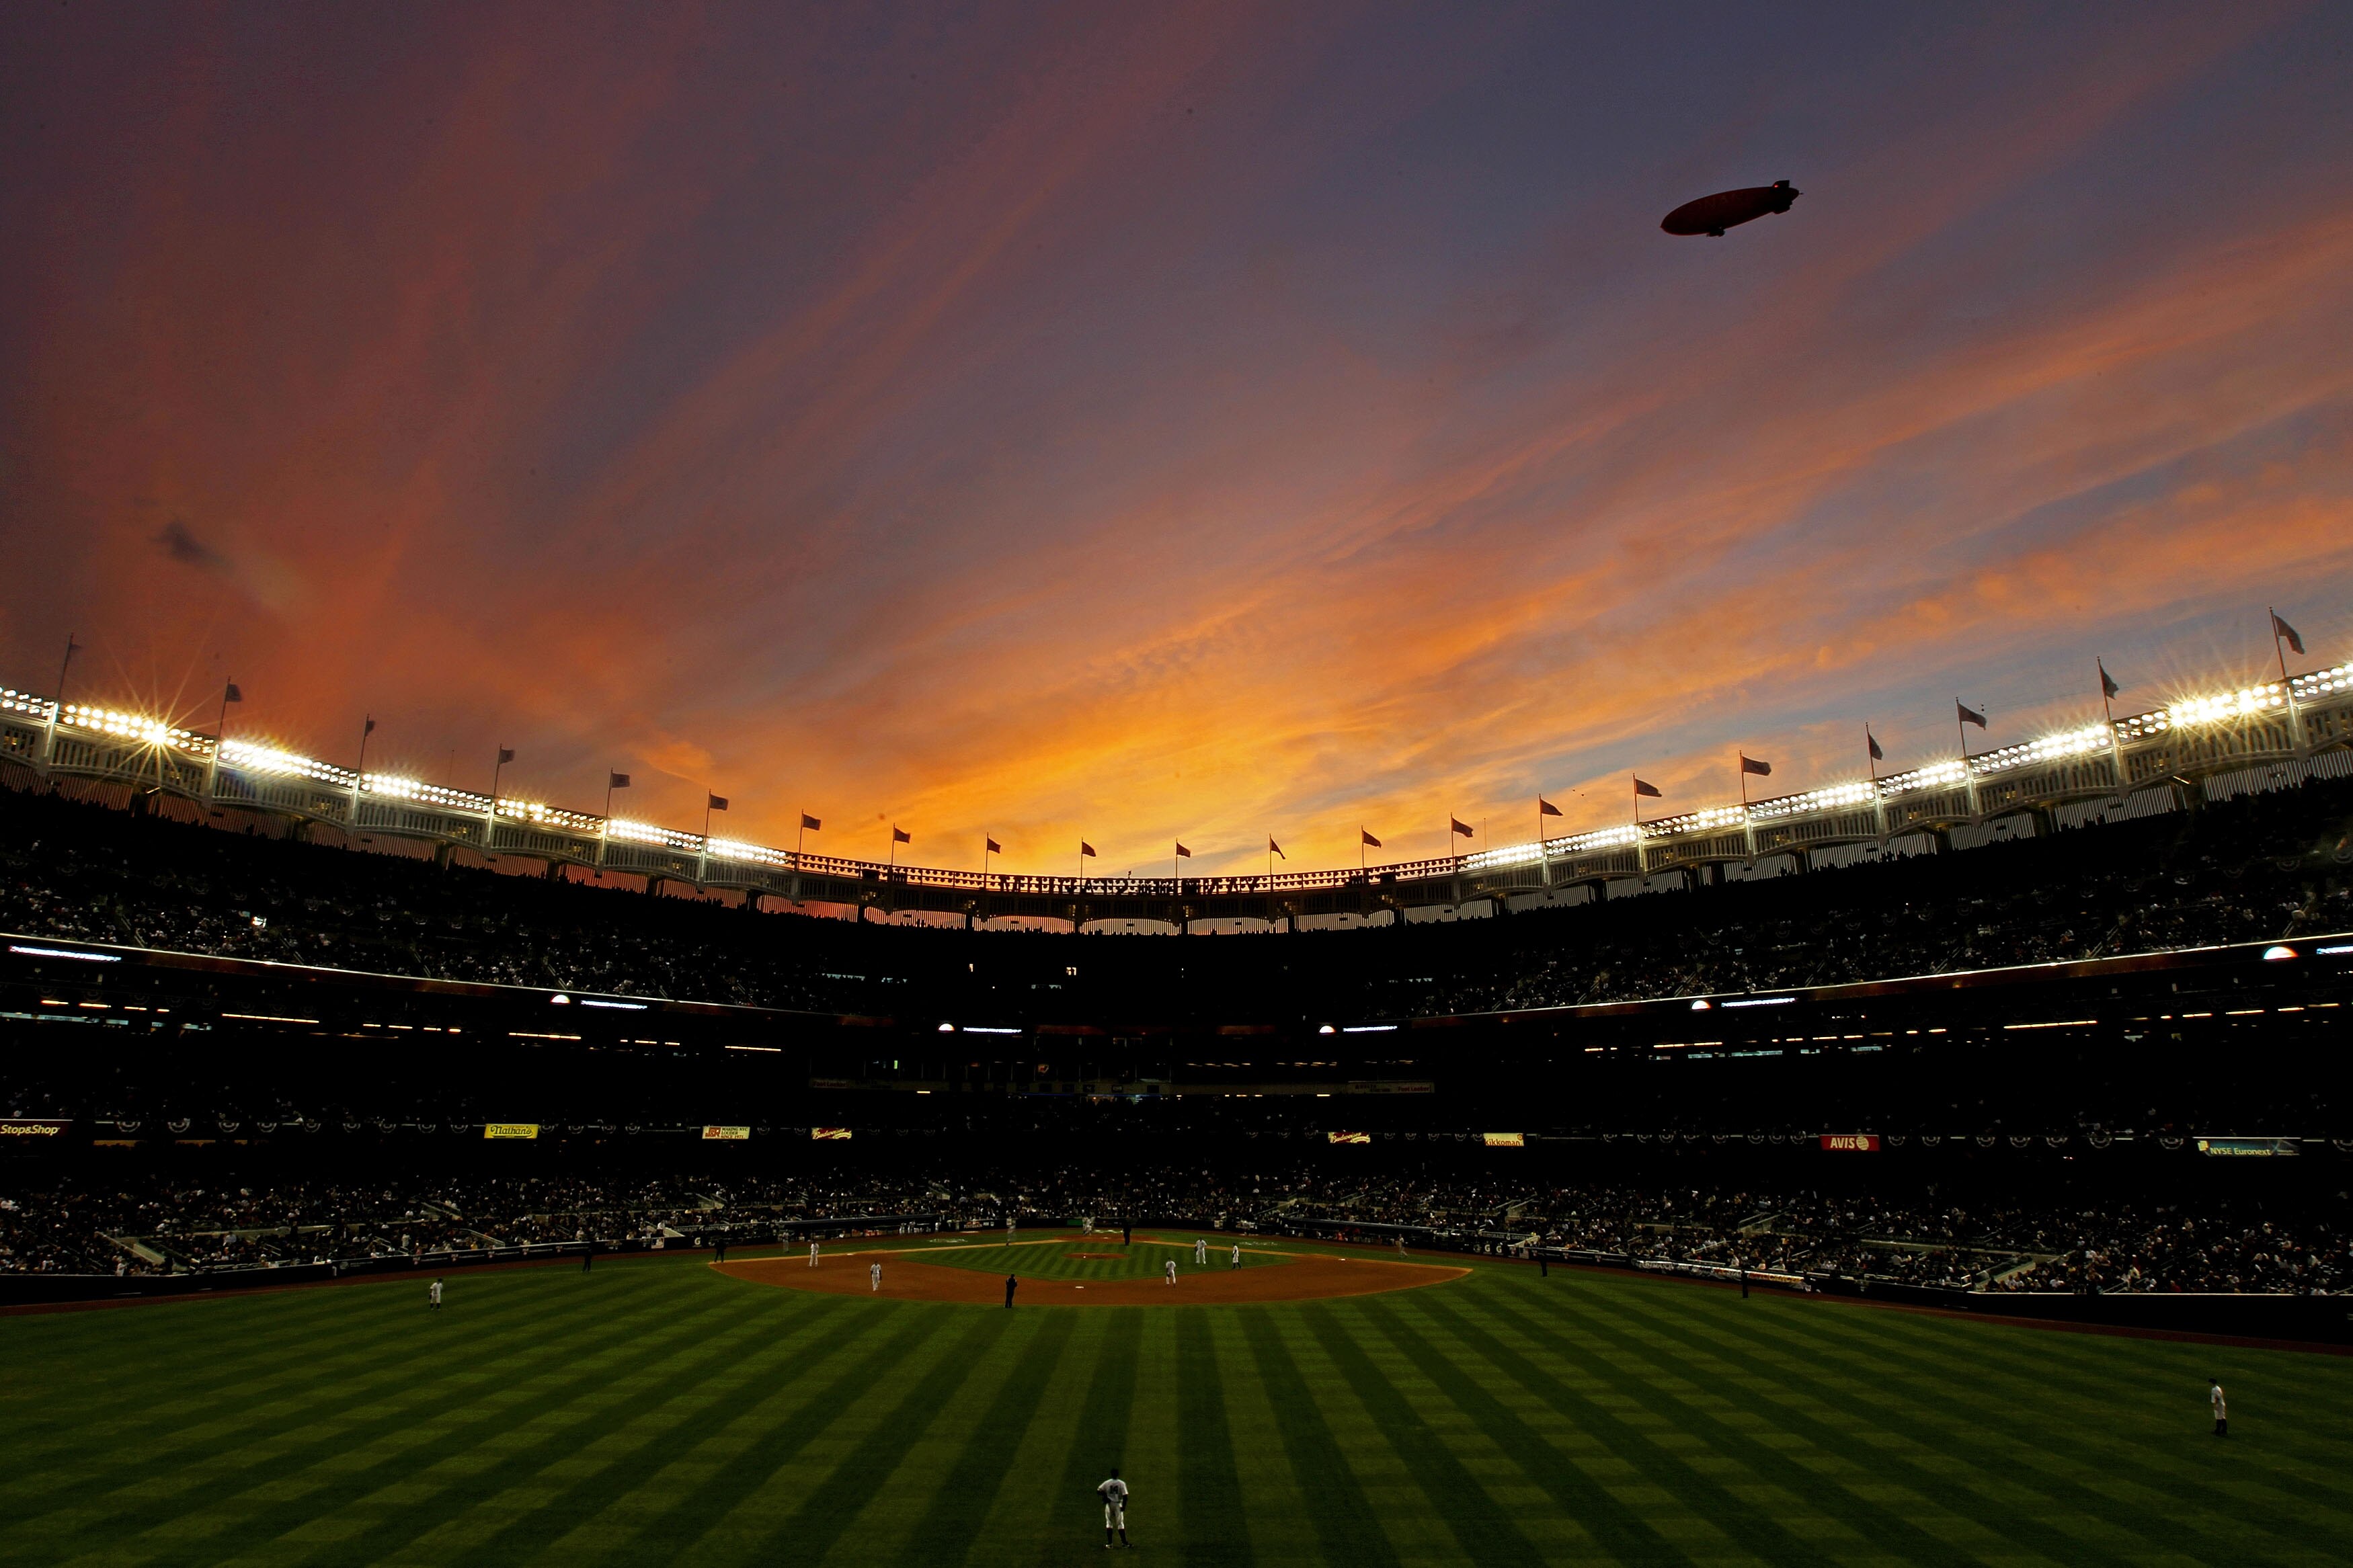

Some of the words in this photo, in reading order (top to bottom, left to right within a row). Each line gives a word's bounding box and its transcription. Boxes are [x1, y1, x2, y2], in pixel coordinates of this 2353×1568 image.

[0, 1124, 60, 1136] Stop&Shop
[490, 1125, 532, 1134] Nathan's
[1830, 1137, 1855, 1149] AVIS
[694, 1237, 701, 1245] G
[1484, 1243, 1491, 1252] G
[1496, 1245, 1503, 1253] G
[1110, 1485, 1118, 1493] 14
